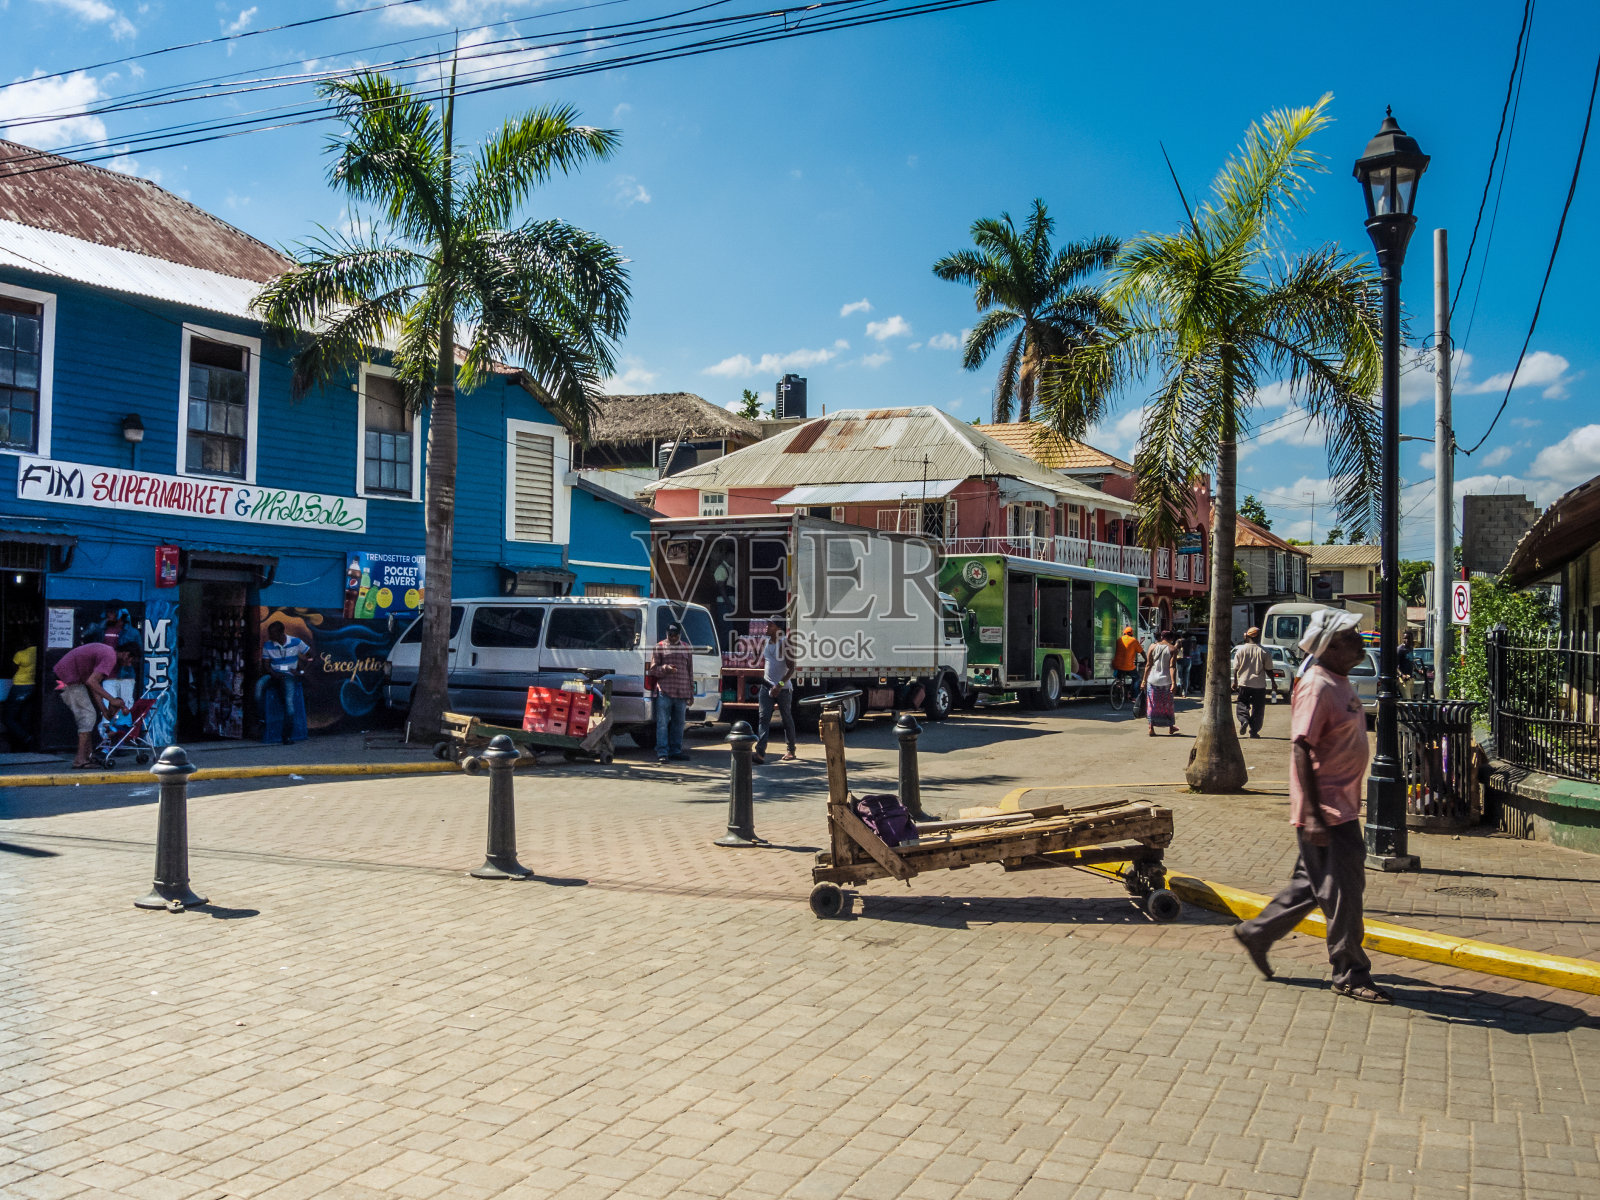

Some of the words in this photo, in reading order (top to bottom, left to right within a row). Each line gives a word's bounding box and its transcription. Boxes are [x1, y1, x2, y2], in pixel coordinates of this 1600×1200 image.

[91, 472, 234, 514] SUPERMARKET
[234, 489, 252, 516] &
[366, 553, 411, 563] TRENDSETTER
[384, 565, 419, 577] POCKET
[383, 576, 416, 587] SAVERS
